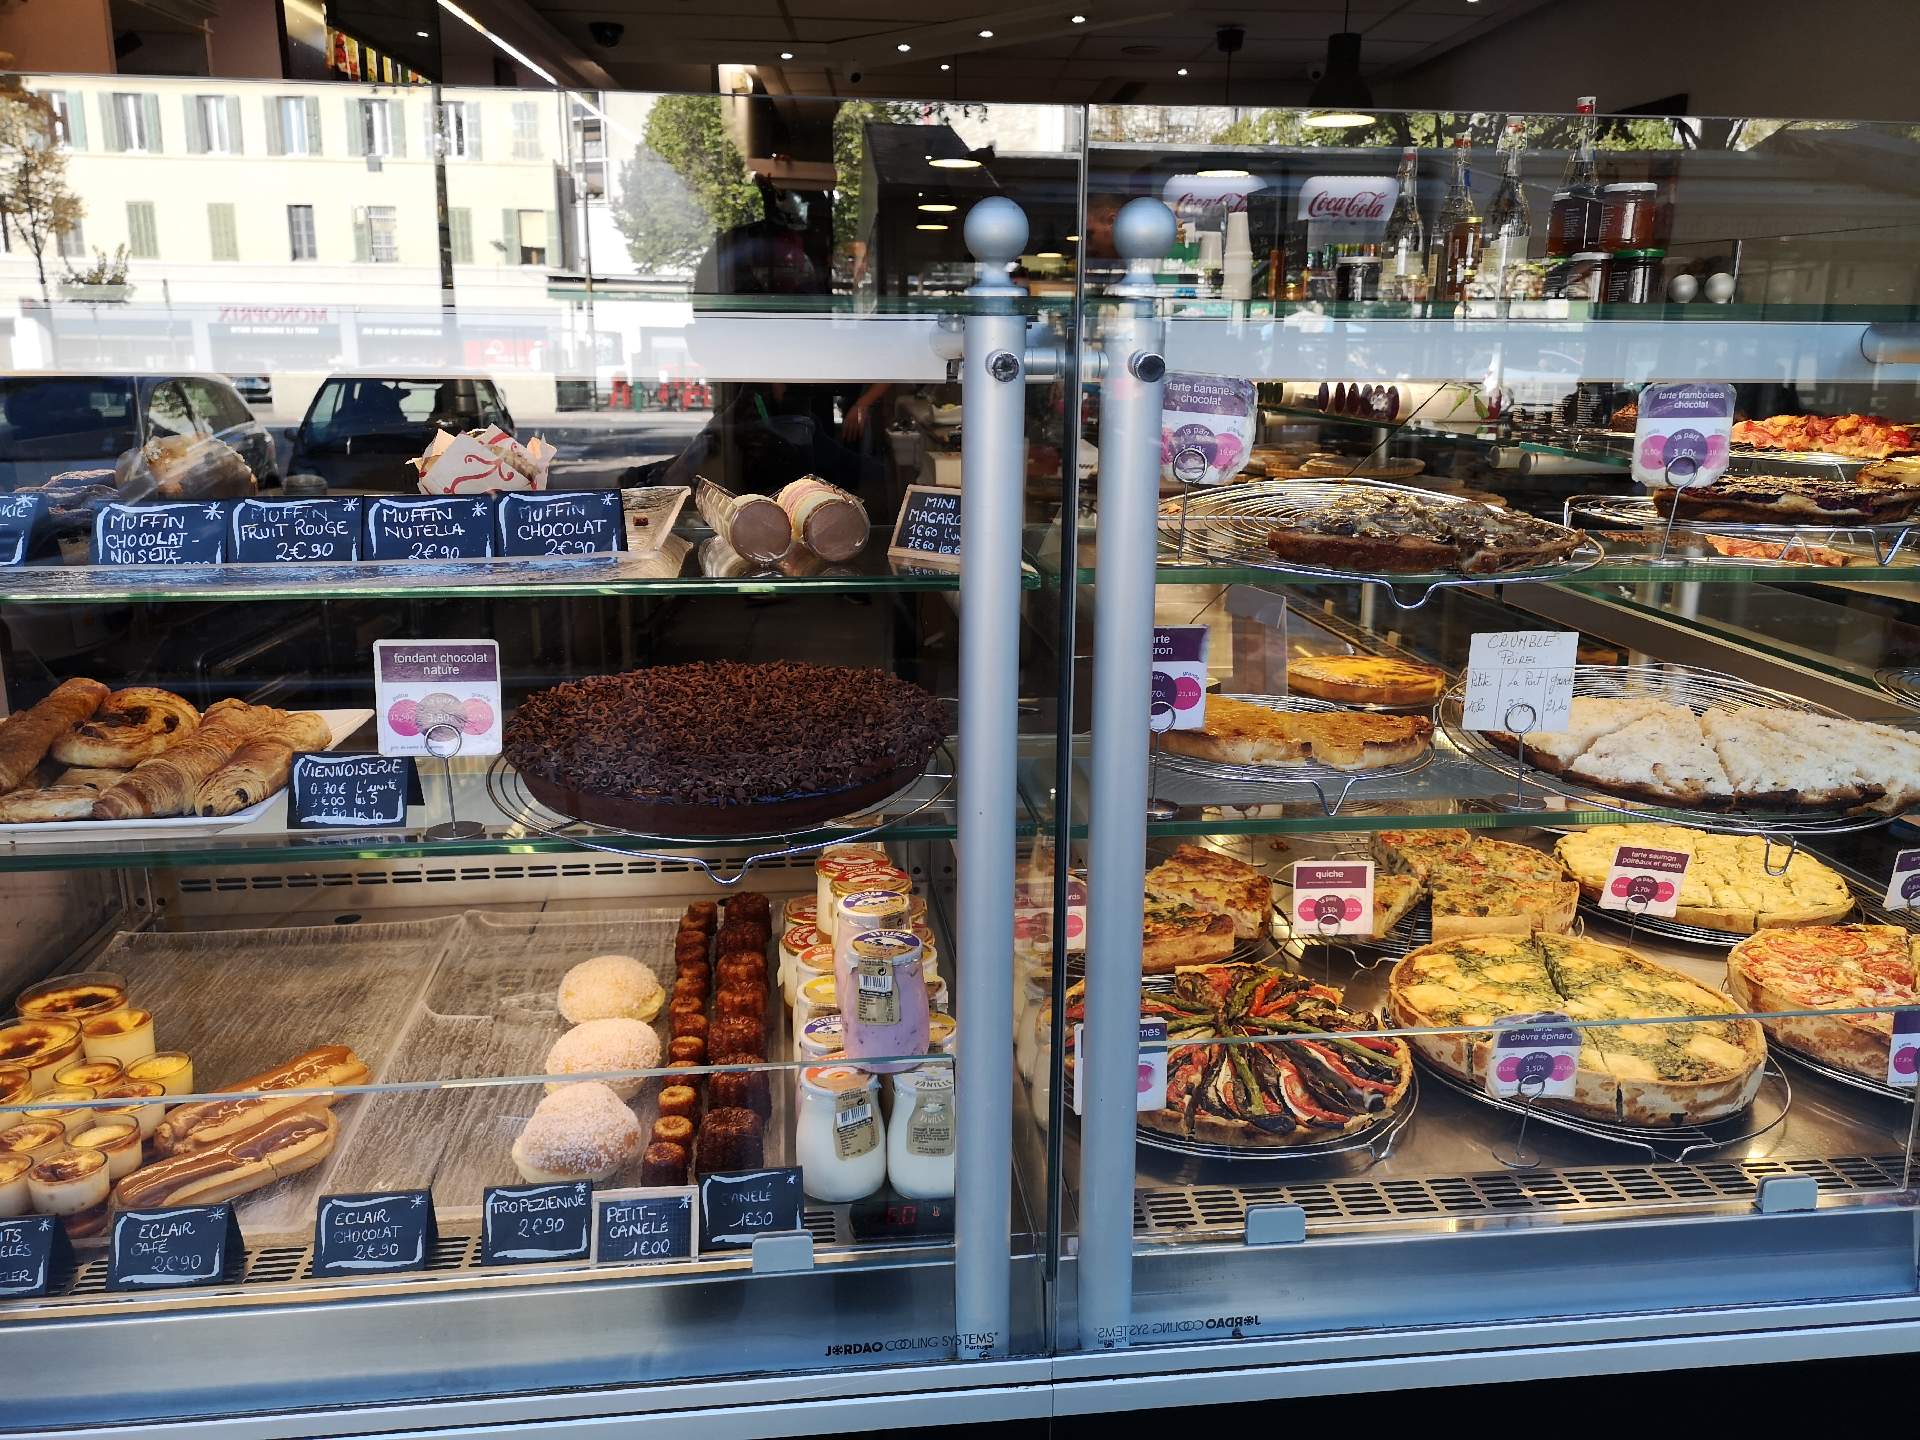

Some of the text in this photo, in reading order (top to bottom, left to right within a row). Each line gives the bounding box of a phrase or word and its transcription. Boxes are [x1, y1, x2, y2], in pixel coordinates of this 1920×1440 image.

[1169, 382, 1235, 396] tarte bananes
[1678, 391, 1725, 399] framboises
[1181, 394, 1222, 406] chocolat
[1674, 400, 1709, 408] chocolat
[0, 503, 28, 518] KIE
[925, 496, 956, 509] MINI
[251, 506, 328, 523] MUFFIN
[383, 508, 452, 523] MUFFIN
[518, 502, 585, 523] MUFFIN
[110, 513, 184, 531] MUFFIN
[241, 519, 348, 541] FRUIT ROUGE
[518, 520, 607, 540] CHOCOLAT
[385, 523, 465, 538] NUTELLA
[909, 524, 938, 537] 1€60
[275, 542, 334, 561] 2€90
[408, 543, 460, 560] 2€90
[545, 539, 595, 556] 2€90
[1487, 633, 1557, 649] CRUMBLE
[393, 652, 488, 663] fondant chocolat
[423, 665, 460, 675] nature
[301, 760, 403, 778] VIENNOISERIE
[370, 792, 379, 804] 5
[1622, 857, 1653, 866] poireaux
[1649, 853, 1677, 862] saumon
[1315, 870, 1344, 880] quiche
[1510, 1032, 1573, 1042] chèvre épinard
[490, 1193, 586, 1214] TROPEZIENNE
[335, 1209, 390, 1225] ECLAIR
[607, 1206, 656, 1223] PETIT-
[139, 1222, 195, 1239] ECLAIR
[334, 1226, 402, 1243] CHOCOLAT
[518, 1217, 564, 1237] 2€90
[610, 1215, 668, 1238] CANELÉ
[131, 1238, 168, 1256] CAFÉ
[354, 1243, 399, 1259] 2€90
[624, 1238, 670, 1257] 1€00
[885, 1336, 938, 1351] COOLING
[964, 1343, 994, 1351] Portugal
